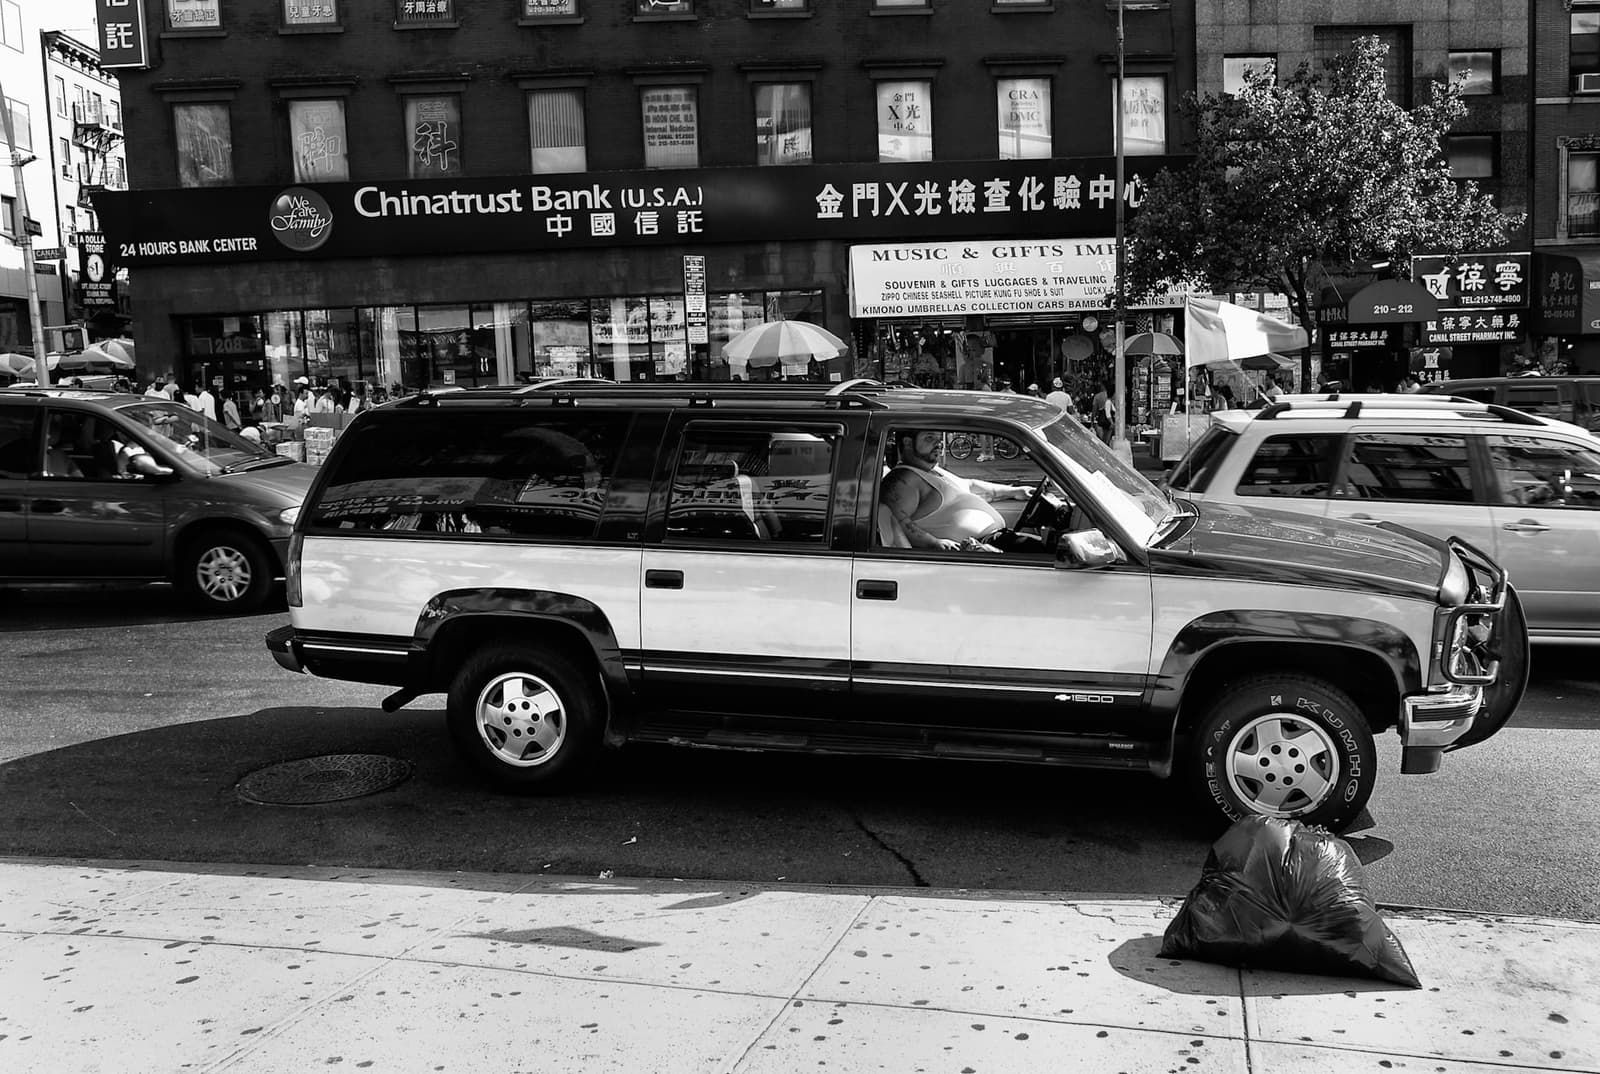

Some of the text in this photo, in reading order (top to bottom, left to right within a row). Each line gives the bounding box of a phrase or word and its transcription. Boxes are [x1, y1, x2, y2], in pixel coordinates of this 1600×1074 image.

[1008, 89, 1039, 100] CRA
[286, 195, 310, 209] We
[353, 184, 704, 217] Chinatrust Bank (U.S.A.)
[298, 207, 317, 218] are
[271, 207, 333, 237] Family
[545, 210, 704, 238] 中國信託
[85, 234, 106, 244] DOLLA
[85, 244, 105, 254] STORE
[119, 237, 258, 257] 24 HOURS BANK CENTER
[872, 247, 948, 262] MUSIC
[962, 247, 979, 259] &
[991, 244, 1064, 259] GIFTS
[885, 275, 1107, 290] SOUVENIR & GIFTS LUGGAGES & TRAVELING
[881, 292, 900, 302] ZIPPO
[903, 291, 929, 301] CHINESE
[931, 290, 962, 300] SEASHELL
[965, 289, 992, 299] PICTURE
[993, 289, 1012, 298] KUNG
[1013, 289, 1022, 297] FU
[1024, 288, 1041, 297] SHOE
[1043, 288, 1048, 296] &
[1050, 287, 1064, 296] SUIT
[862, 305, 904, 315] KIMONO
[907, 303, 967, 313] UMBRELLAS
[971, 301, 1033, 311] COLLECTION
[1037, 300, 1065, 310] CARS
[1373, 305, 1389, 314] 210
[1397, 304, 1413, 314] 212
[1429, 331, 1517, 342] CANAL STREET PHARMACY INC.
[1071, 694, 1114, 704] 1500
[1296, 697, 1361, 802] KUMHO
